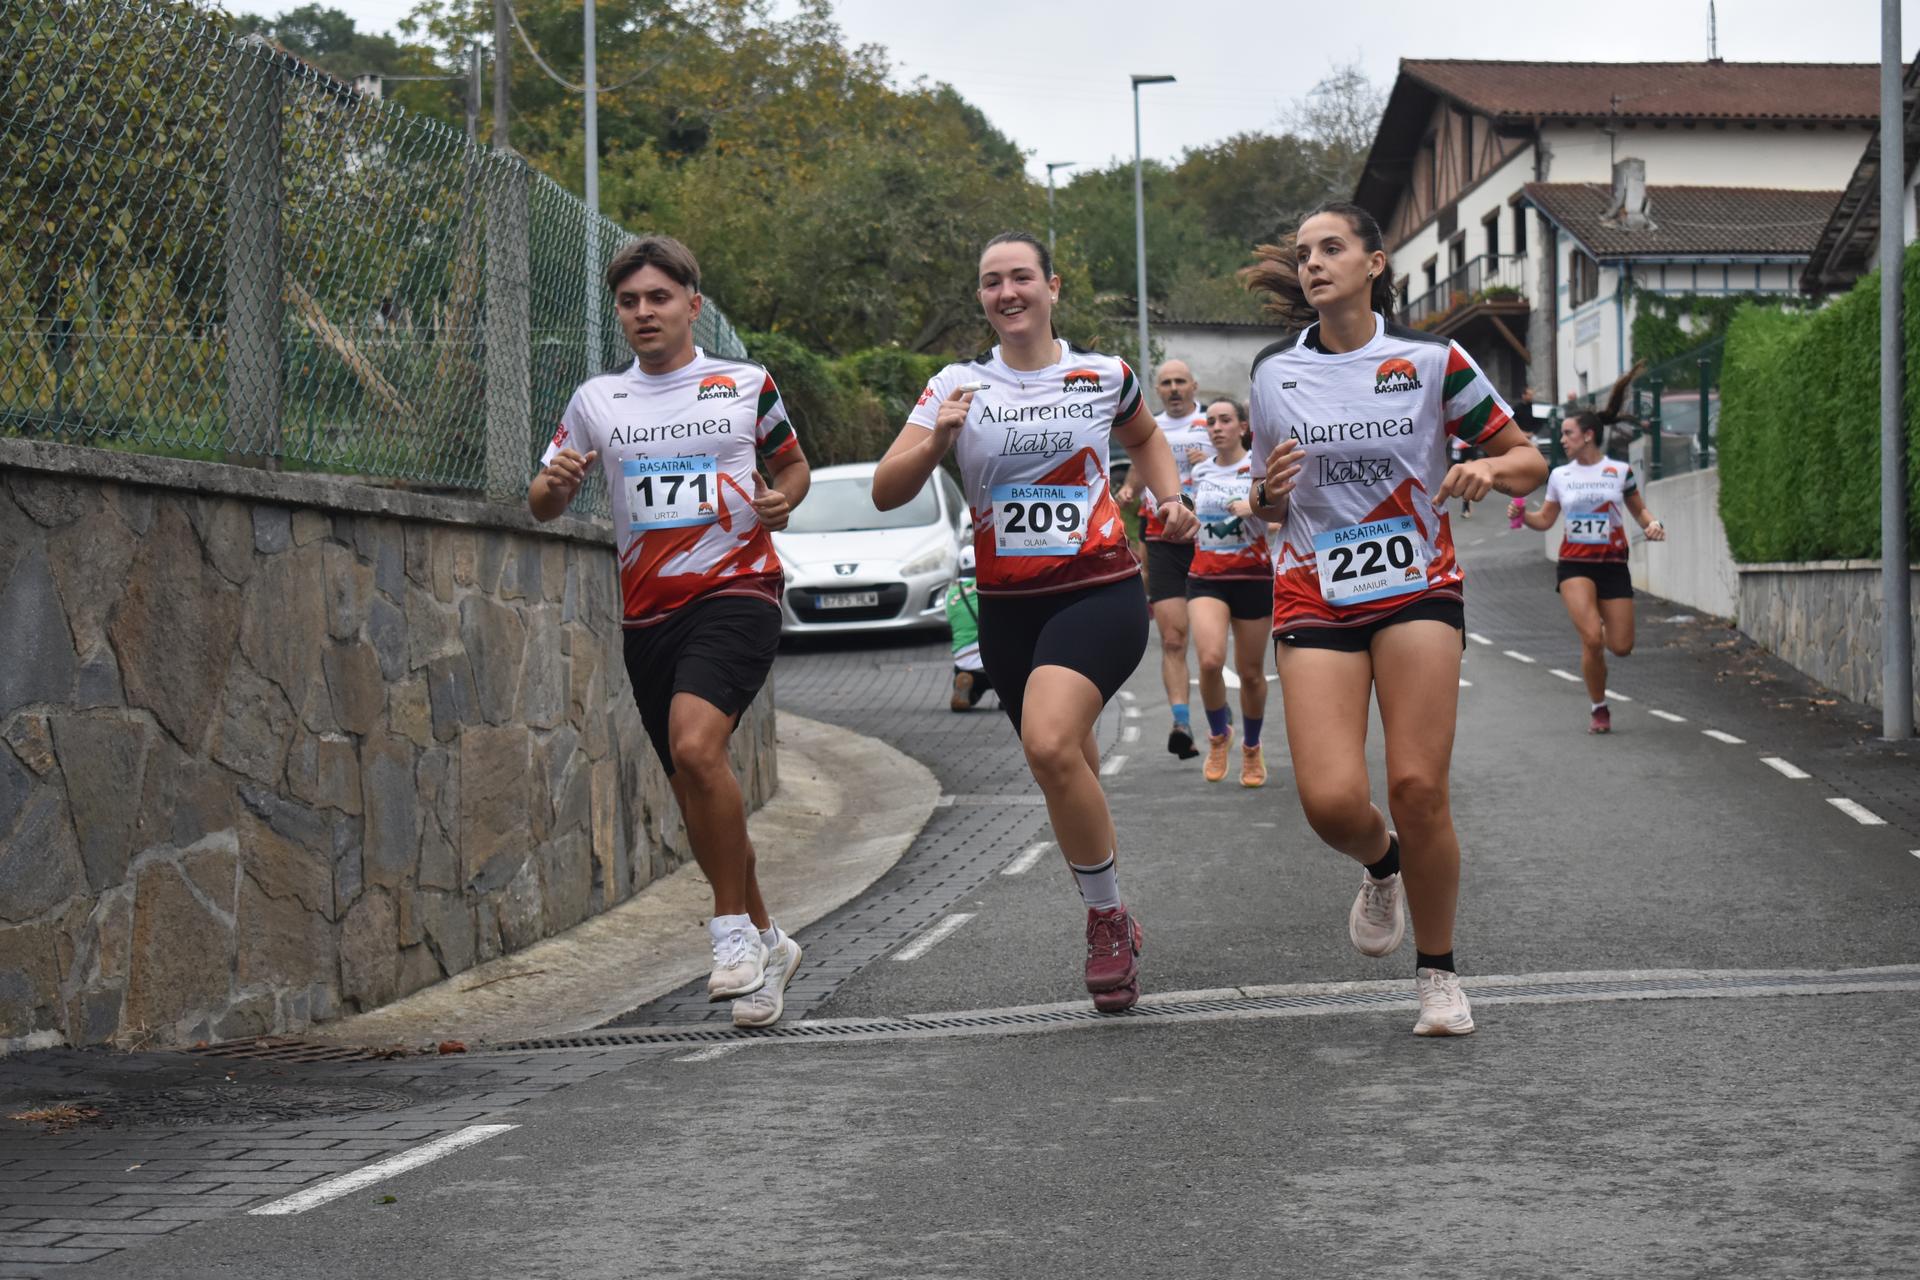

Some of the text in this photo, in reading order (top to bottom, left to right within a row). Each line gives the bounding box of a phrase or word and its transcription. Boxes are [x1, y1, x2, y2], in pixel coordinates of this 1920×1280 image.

[697, 390, 740, 401] BASATRAIL
[1374, 380, 1423, 394] BASATRAIL
[978, 403, 1093, 425] Alarrenea
[608, 417, 732, 447] Alarrenea
[1290, 417, 1414, 446] Alarrenea
[999, 427, 1074, 458] Ikatza
[640, 461, 694, 473] BASATRAIL
[1315, 455, 1393, 487] Ikatza
[636, 474, 708, 507] 171
[1011, 488, 1066, 499] BASATRAIL
[655, 511, 678, 519] URTZI
[1003, 502, 1081, 533] 209
[1334, 522, 1393, 543] BASATRAIL
[1571, 520, 1606, 534] 217
[1023, 539, 1048, 547] OLAIA
[1328, 535, 1414, 583] 220
[1352, 579, 1388, 593] AMAIUR
